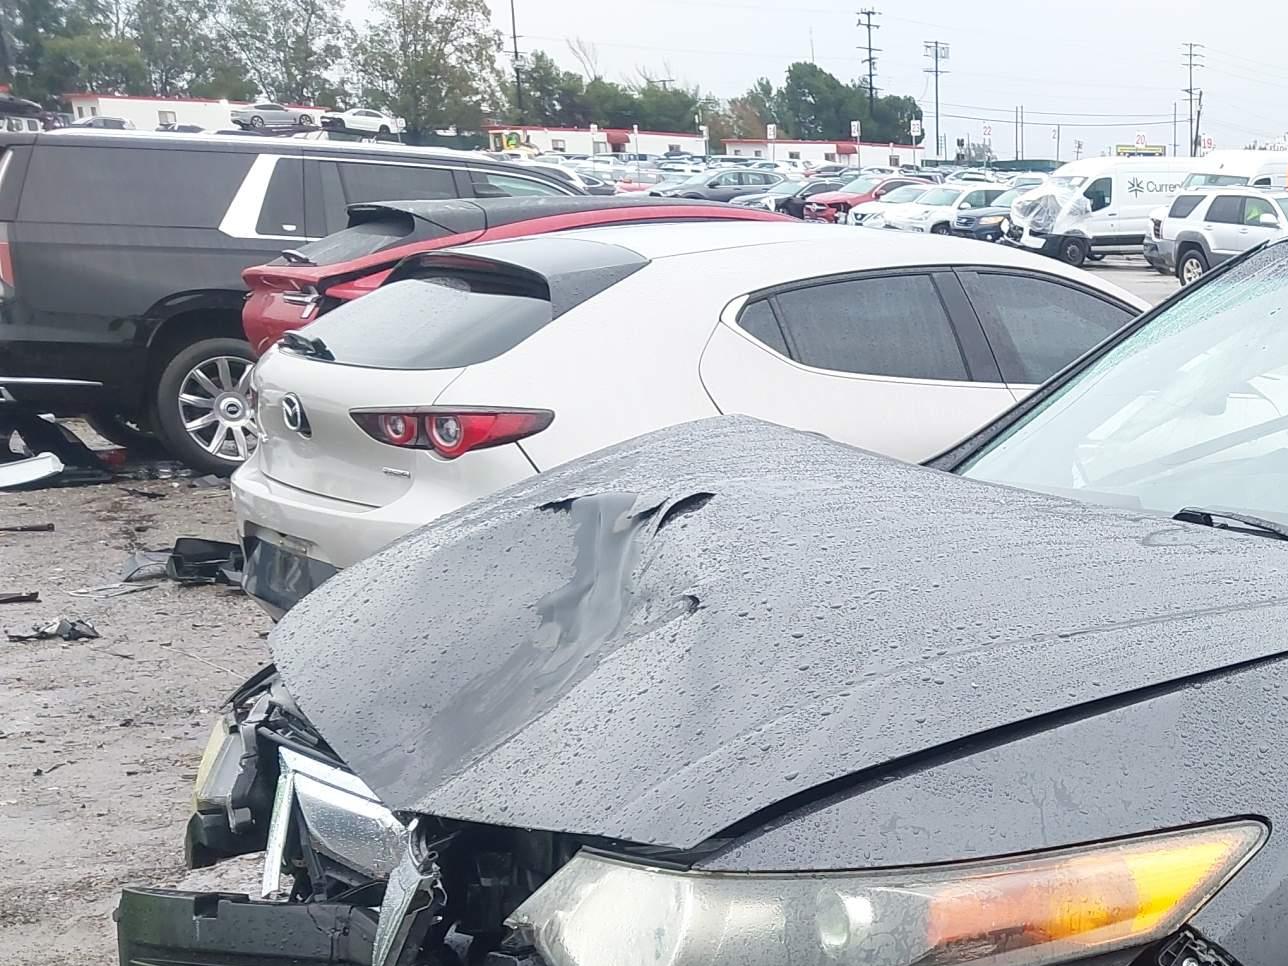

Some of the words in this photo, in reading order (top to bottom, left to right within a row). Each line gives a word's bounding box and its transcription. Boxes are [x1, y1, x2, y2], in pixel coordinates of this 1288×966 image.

[983, 126, 992, 136] 22
[1136, 134, 1145, 145] 20
[1202, 138, 1212, 149] 19
